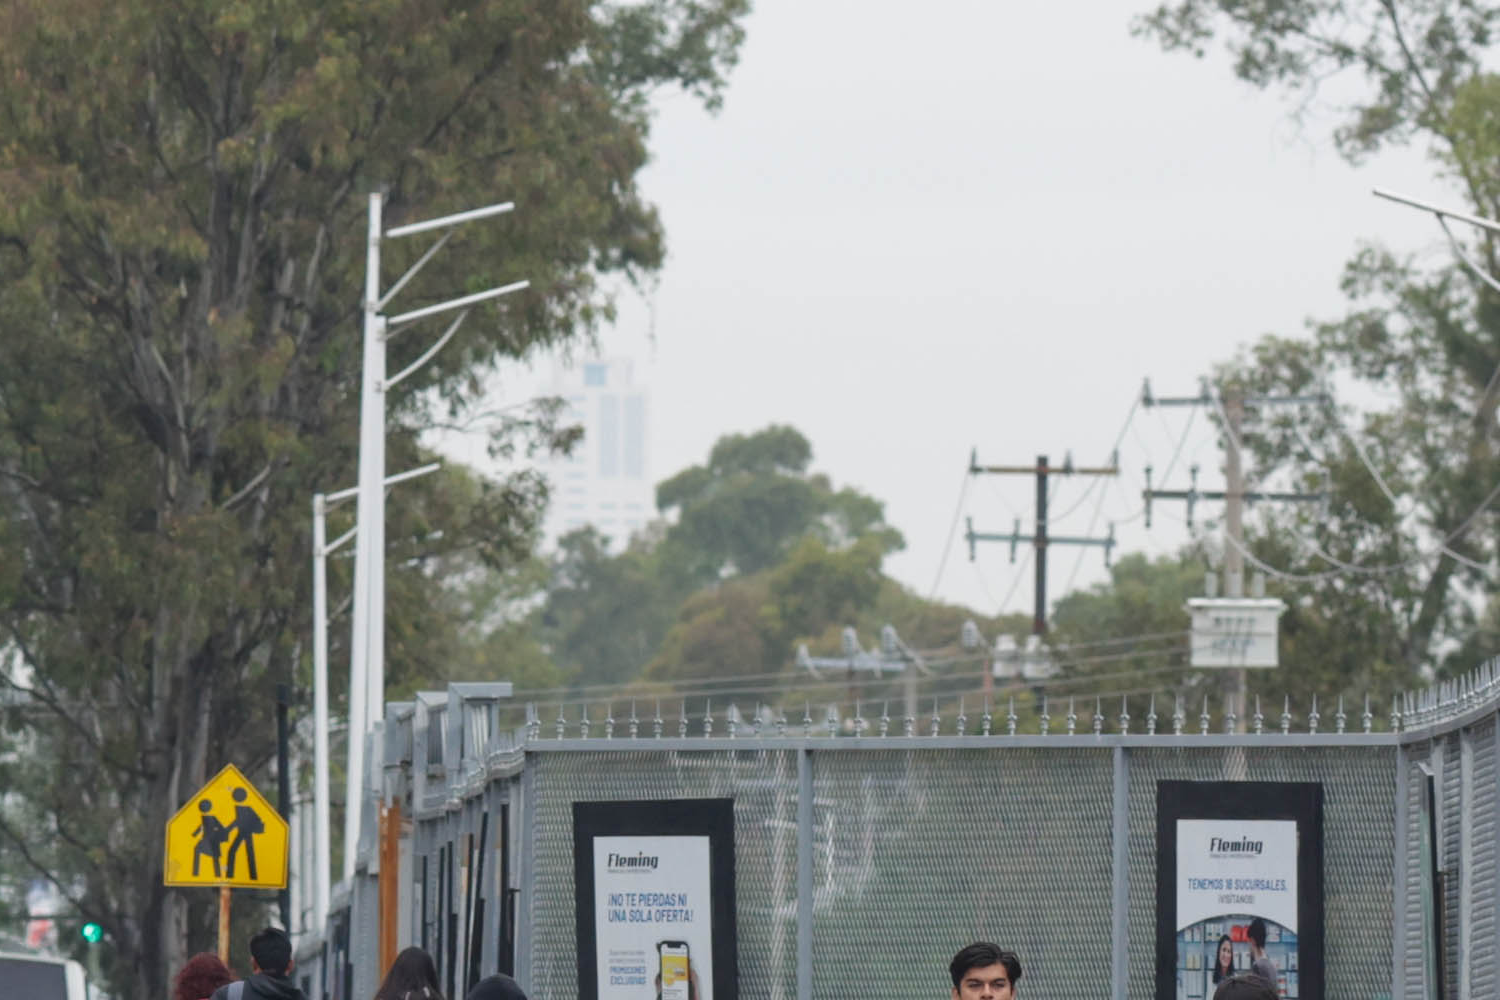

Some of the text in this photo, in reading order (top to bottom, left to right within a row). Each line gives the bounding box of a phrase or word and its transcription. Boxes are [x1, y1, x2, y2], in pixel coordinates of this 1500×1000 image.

[1209, 836, 1263, 854] Fleming
[607, 851, 659, 869] Fleming
[1188, 878, 1224, 890] TENEMOS
[626, 893, 637, 907] TE
[639, 893, 676, 907] PIERDAS
[678, 893, 688, 907] NI
[608, 909, 693, 922] UNA SOLA OFERTA!
